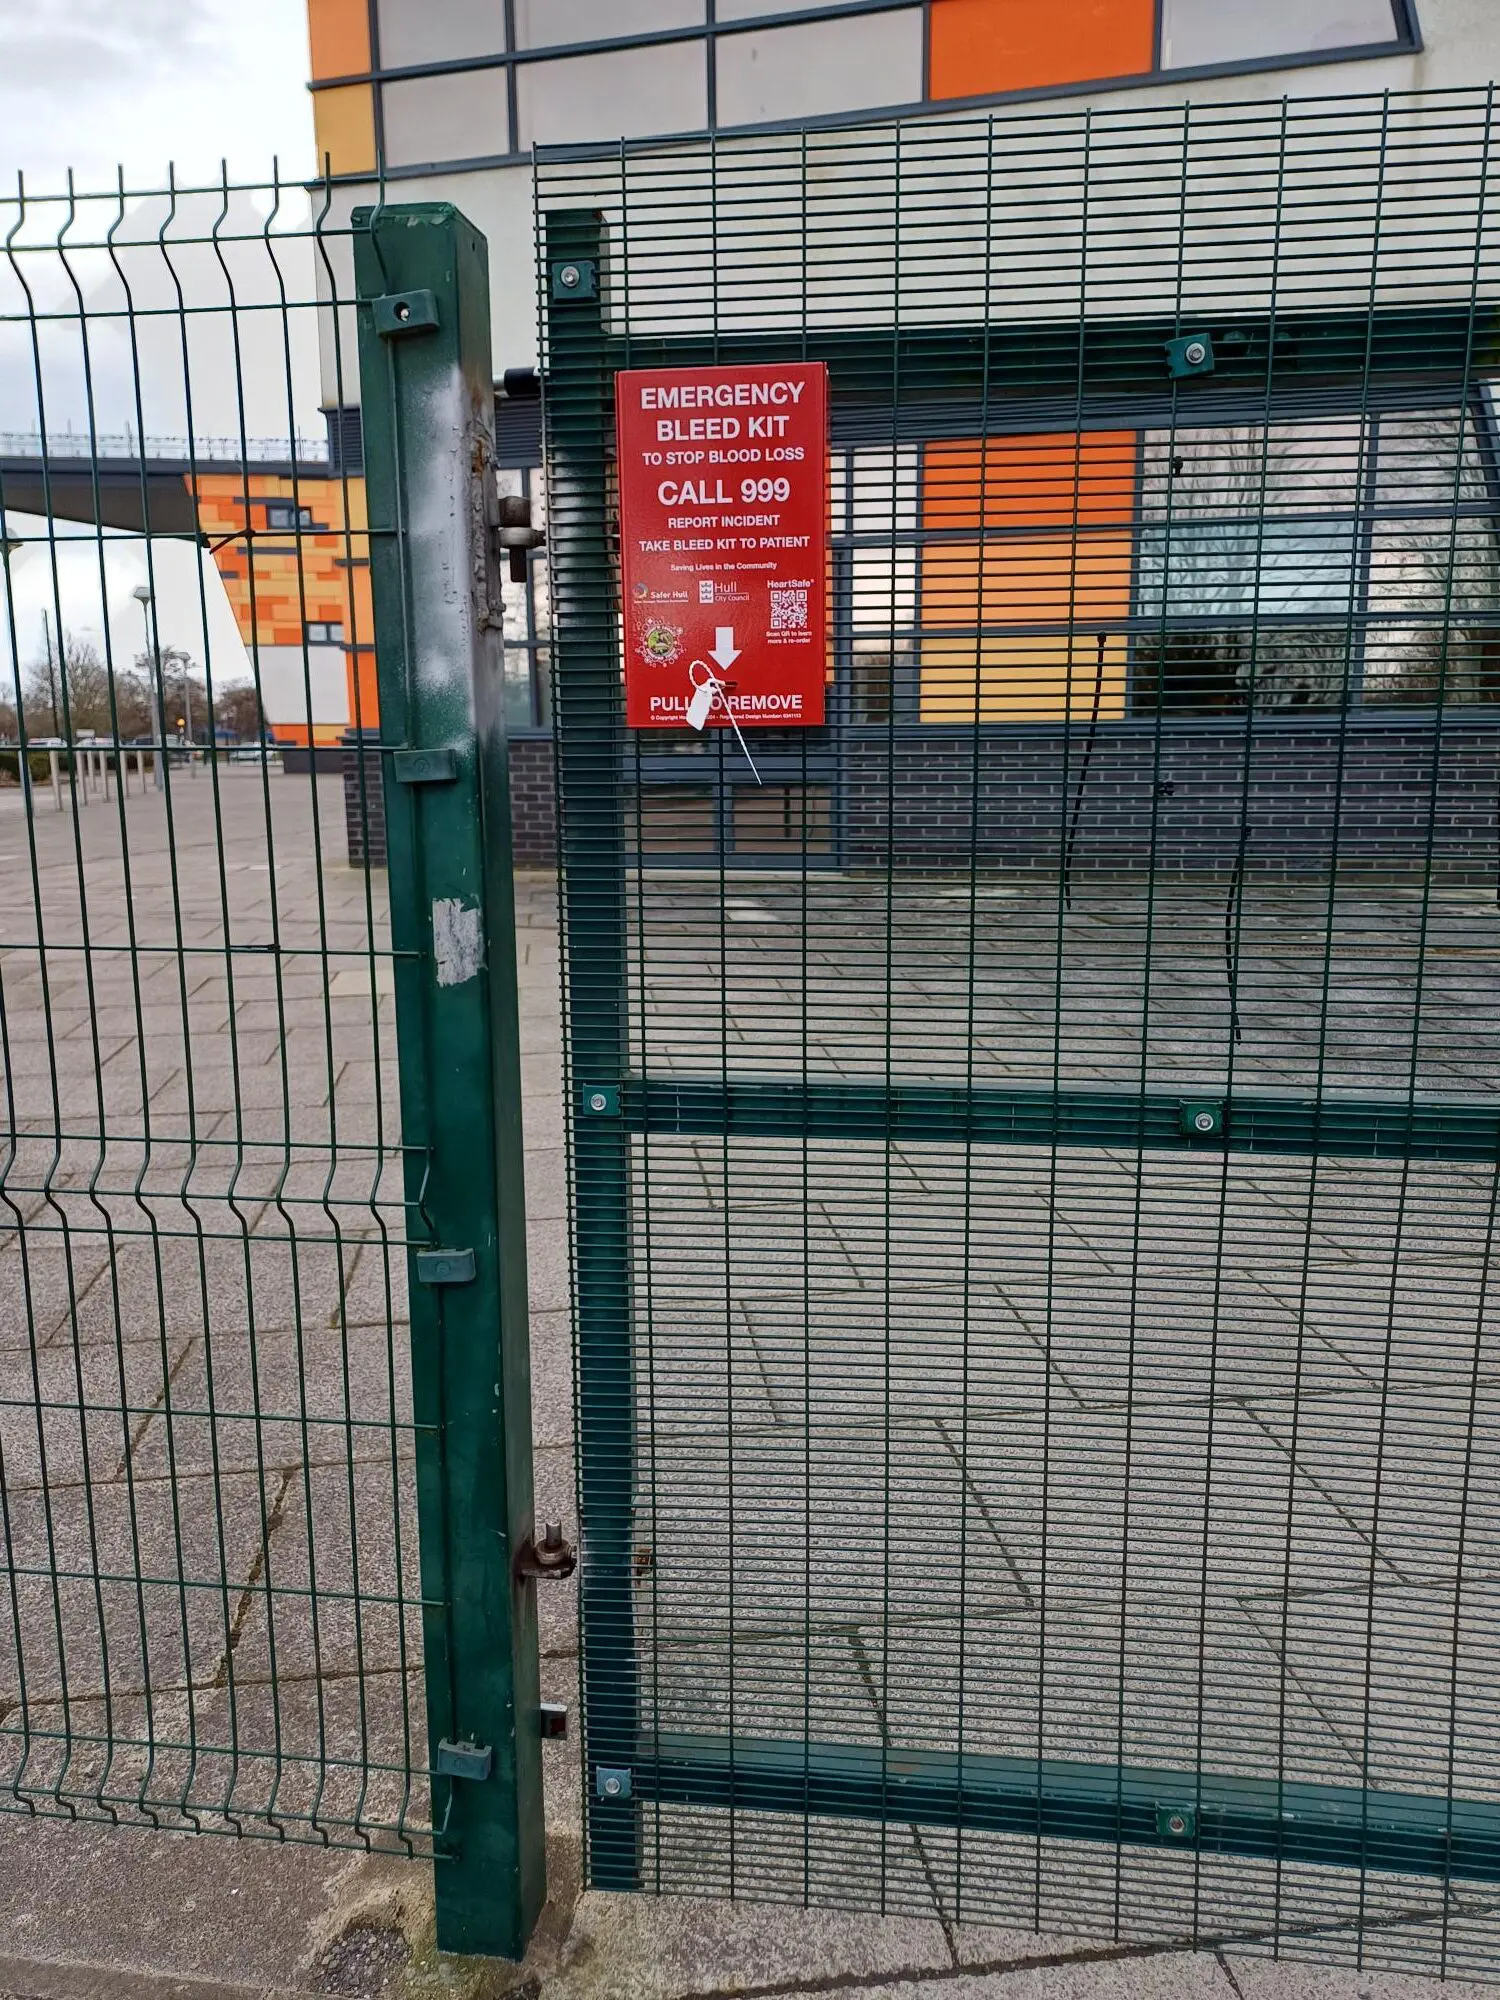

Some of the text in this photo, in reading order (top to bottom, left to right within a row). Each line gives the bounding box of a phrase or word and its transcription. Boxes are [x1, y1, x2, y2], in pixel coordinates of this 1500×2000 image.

[641, 381, 805, 409] EMERGENCY
[656, 416, 789, 441] BLEED KIT
[642, 447, 805, 465] TO STOP BLOOD LOSS
[658, 478, 790, 506] CALL 999
[668, 515, 780, 528] REPORT INCIDENT
[639, 536, 810, 552] TAKE BLEED KIT TO PATIENT
[670, 564, 694, 572] Saving
[695, 563, 714, 571] Lives
[736, 562, 777, 570] Community
[650, 590, 688, 599] Safer Hull
[714, 581, 737, 593] Hull
[650, 696, 689, 711] PULL
[727, 694, 803, 710] REMOVE
